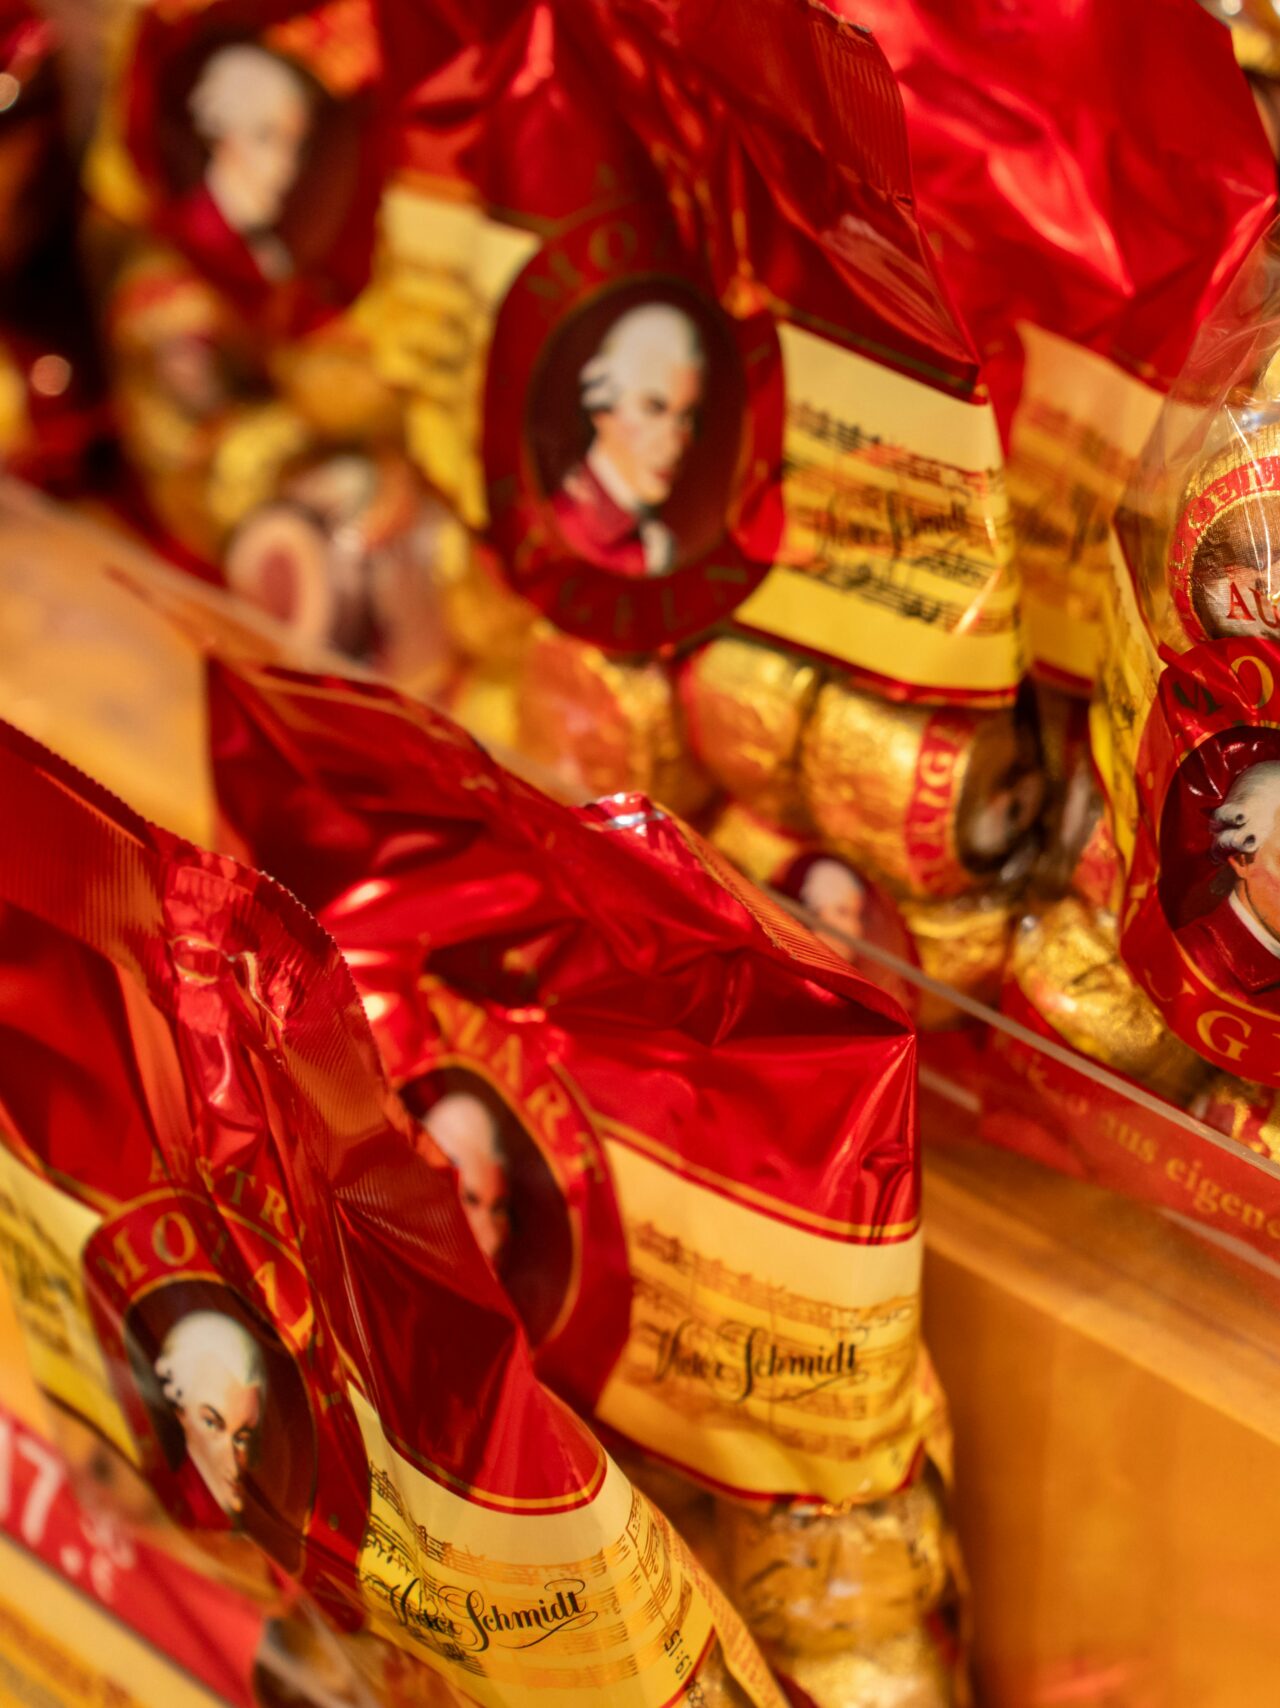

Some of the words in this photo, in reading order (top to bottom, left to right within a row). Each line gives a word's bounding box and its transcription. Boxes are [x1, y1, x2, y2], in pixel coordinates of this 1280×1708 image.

[1168, 466, 1276, 590] UGEL
[718, 1322, 868, 1404] Schmidt
[438, 1577, 598, 1652] Schmidt
